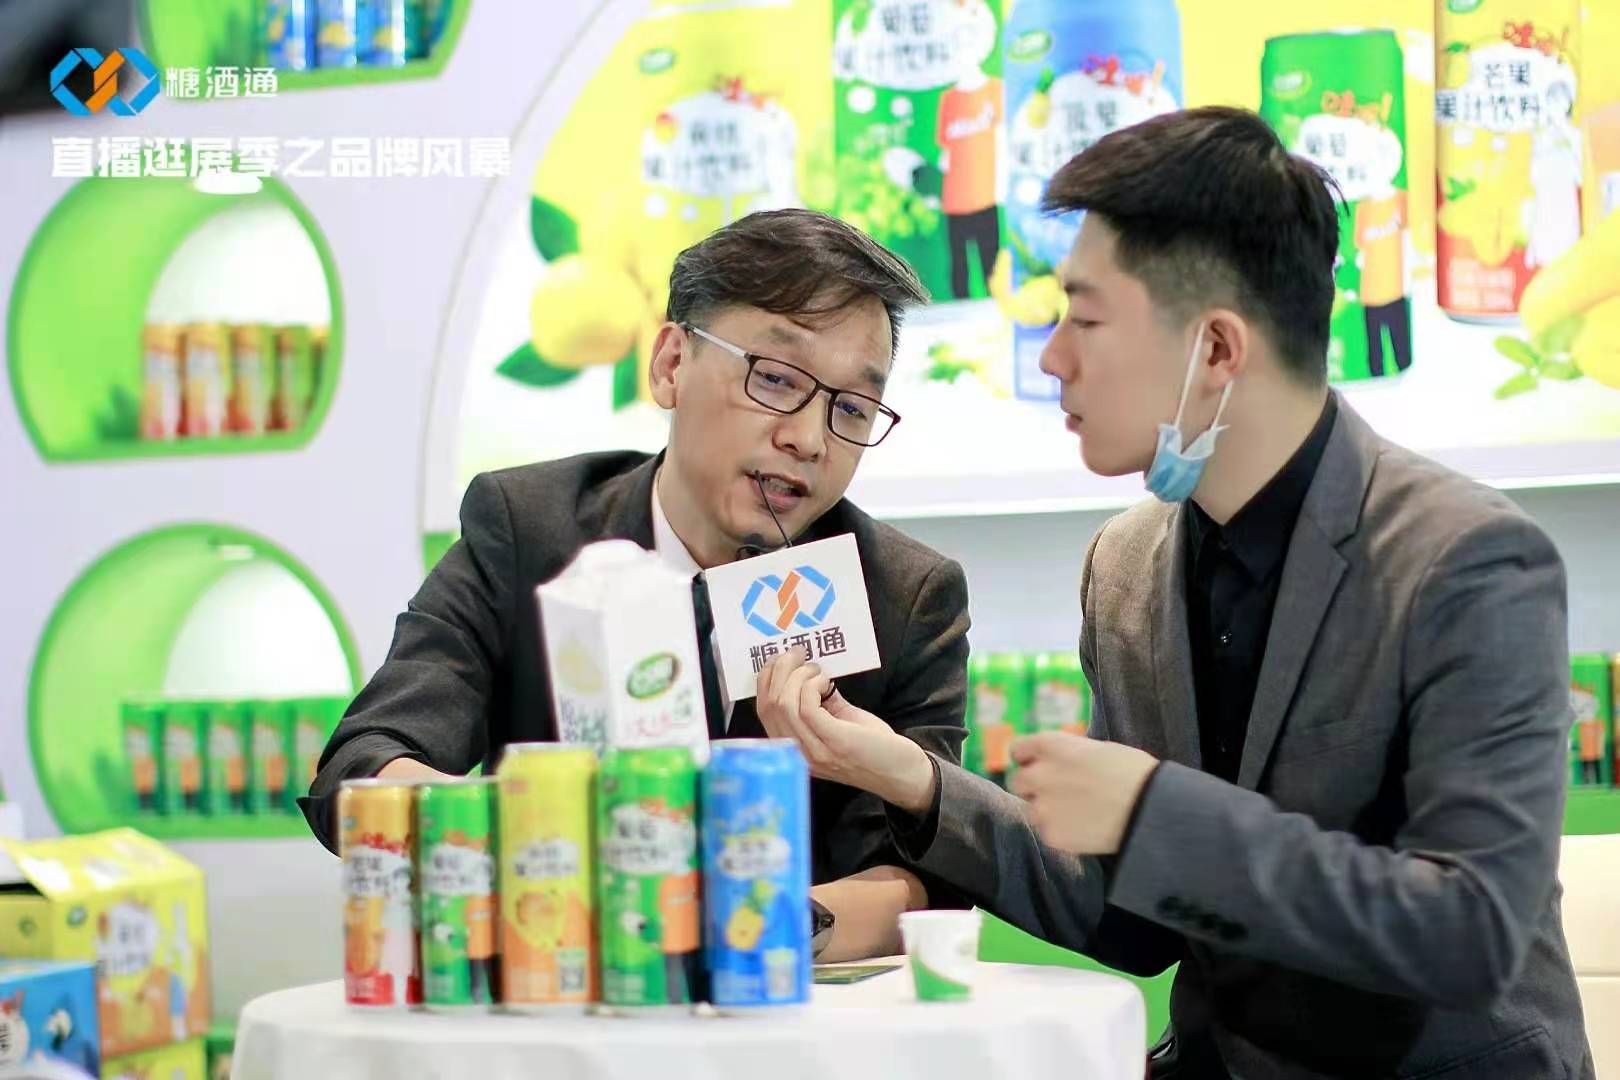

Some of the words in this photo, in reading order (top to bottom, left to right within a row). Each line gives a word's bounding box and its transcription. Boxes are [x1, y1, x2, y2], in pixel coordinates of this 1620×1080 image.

[1485, 60, 1531, 88] 芒果
[1436, 91, 1541, 123] 果汁饮料
